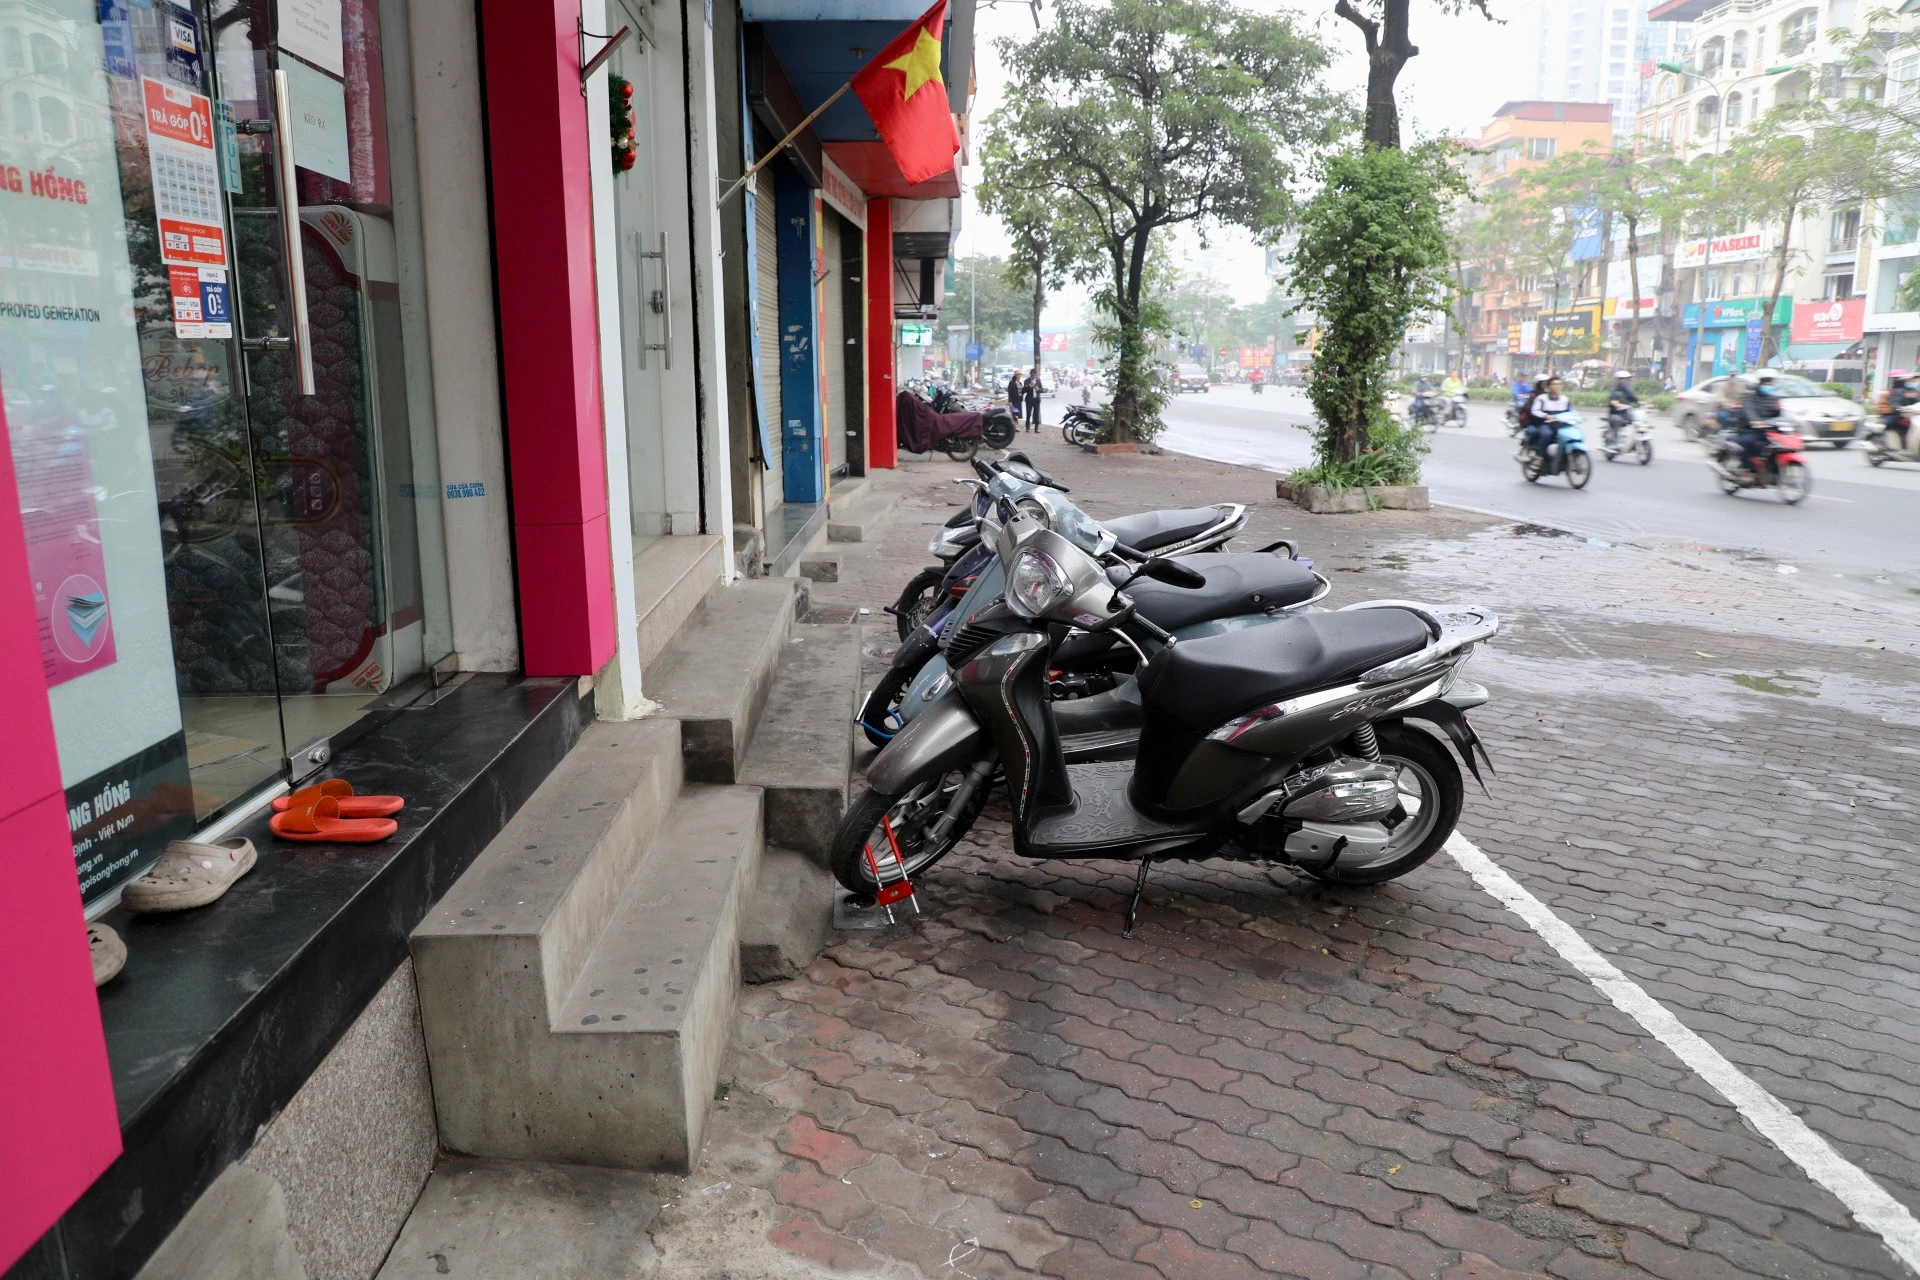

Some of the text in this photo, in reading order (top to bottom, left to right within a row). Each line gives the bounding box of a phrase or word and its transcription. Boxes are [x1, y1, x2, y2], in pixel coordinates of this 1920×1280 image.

[174, 26, 193, 45] VISA
[151, 107, 168, 126] TRẢ
[169, 109, 189, 131] GÓP
[225, 126, 240, 190] PULL
[1697, 234, 1761, 256] DNASEIKI
[0, 302, 101, 322] PROVED GENERATION
[66, 780, 131, 832] NG HỒNG
[73, 838, 93, 858] Định
[98, 823, 116, 842] Việt
[116, 813, 135, 831] Nam
